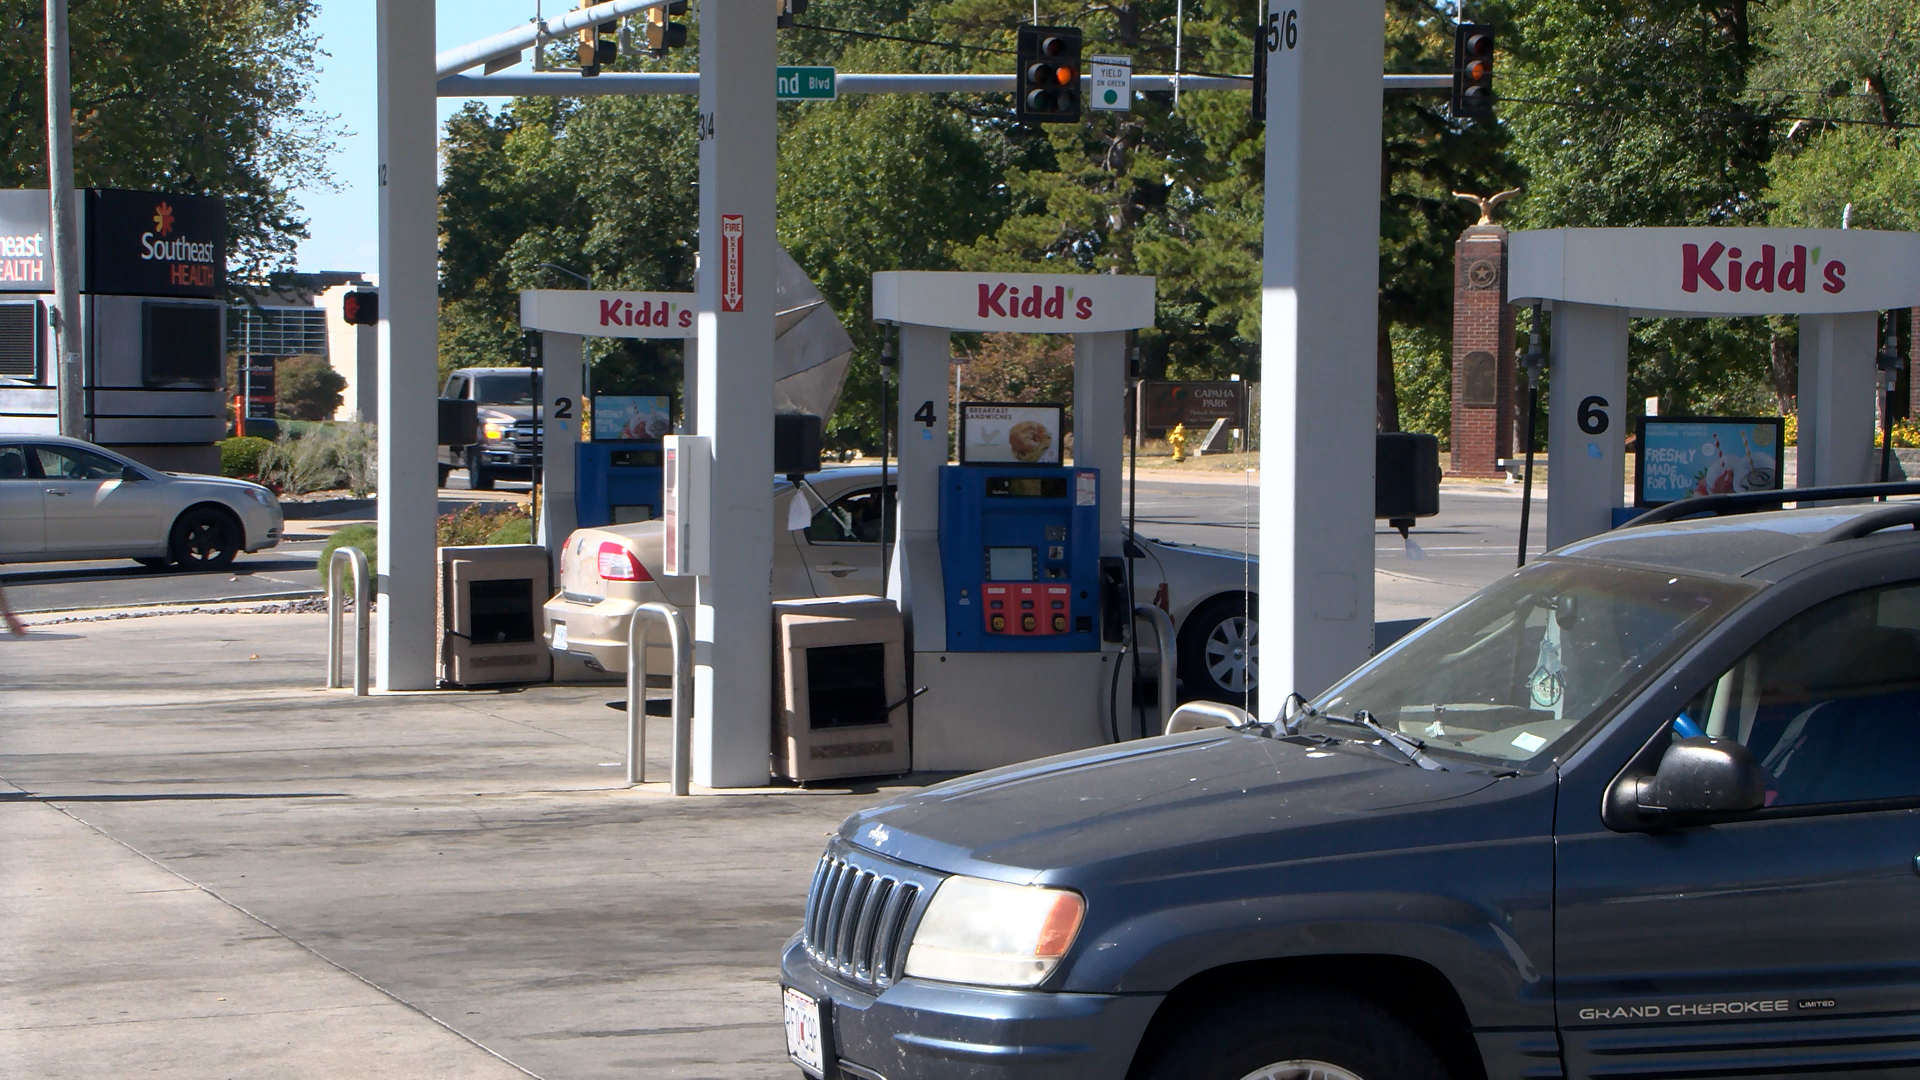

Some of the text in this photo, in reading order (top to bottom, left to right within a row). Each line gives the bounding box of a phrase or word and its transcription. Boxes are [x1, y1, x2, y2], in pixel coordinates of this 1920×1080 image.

[1268, 9, 1297, 52] 5/6
[778, 72, 830, 94] nd Blvd
[1101, 69, 1123, 78] YIELD
[700, 112, 714, 141] 3/4
[725, 223, 741, 232] FIRE
[141, 232, 214, 263] Southeast
[171, 264, 214, 287] HEALTH
[1682, 241, 1846, 294] Kidd's
[977, 282, 1093, 320] Kidd's
[600, 298, 693, 328] Kidd's
[1194, 389, 1234, 398] CAPAHA
[1202, 399, 1228, 408] PARK
[554, 397, 572, 419] 2
[914, 400, 937, 428] 4
[1577, 395, 1610, 435] 6
[1645, 447, 1697, 465] FRESHLY
[1646, 463, 1678, 477] MADE
[1646, 473, 1692, 490] FOR YOU
[1579, 999, 1835, 1020] GRAND CHEROKEE LIMITED
